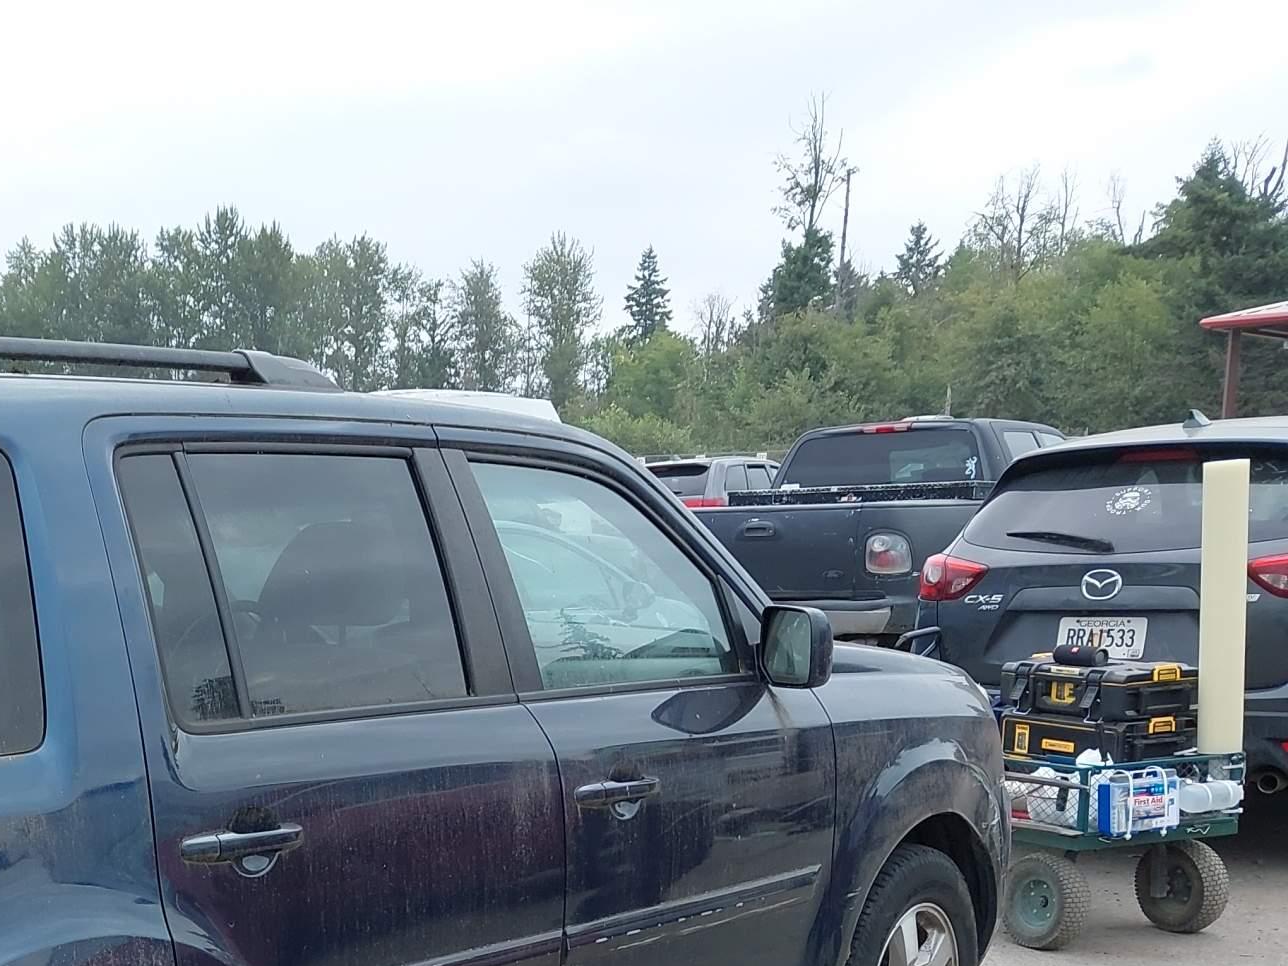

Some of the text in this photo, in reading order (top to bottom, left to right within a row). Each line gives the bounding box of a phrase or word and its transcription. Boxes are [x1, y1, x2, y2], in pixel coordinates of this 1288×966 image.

[964, 594, 1004, 604] CX-5
[1079, 619, 1126, 628] GEORGIA
[1065, 628, 1136, 648] RRA1533
[1133, 796, 1164, 806] First Aid
